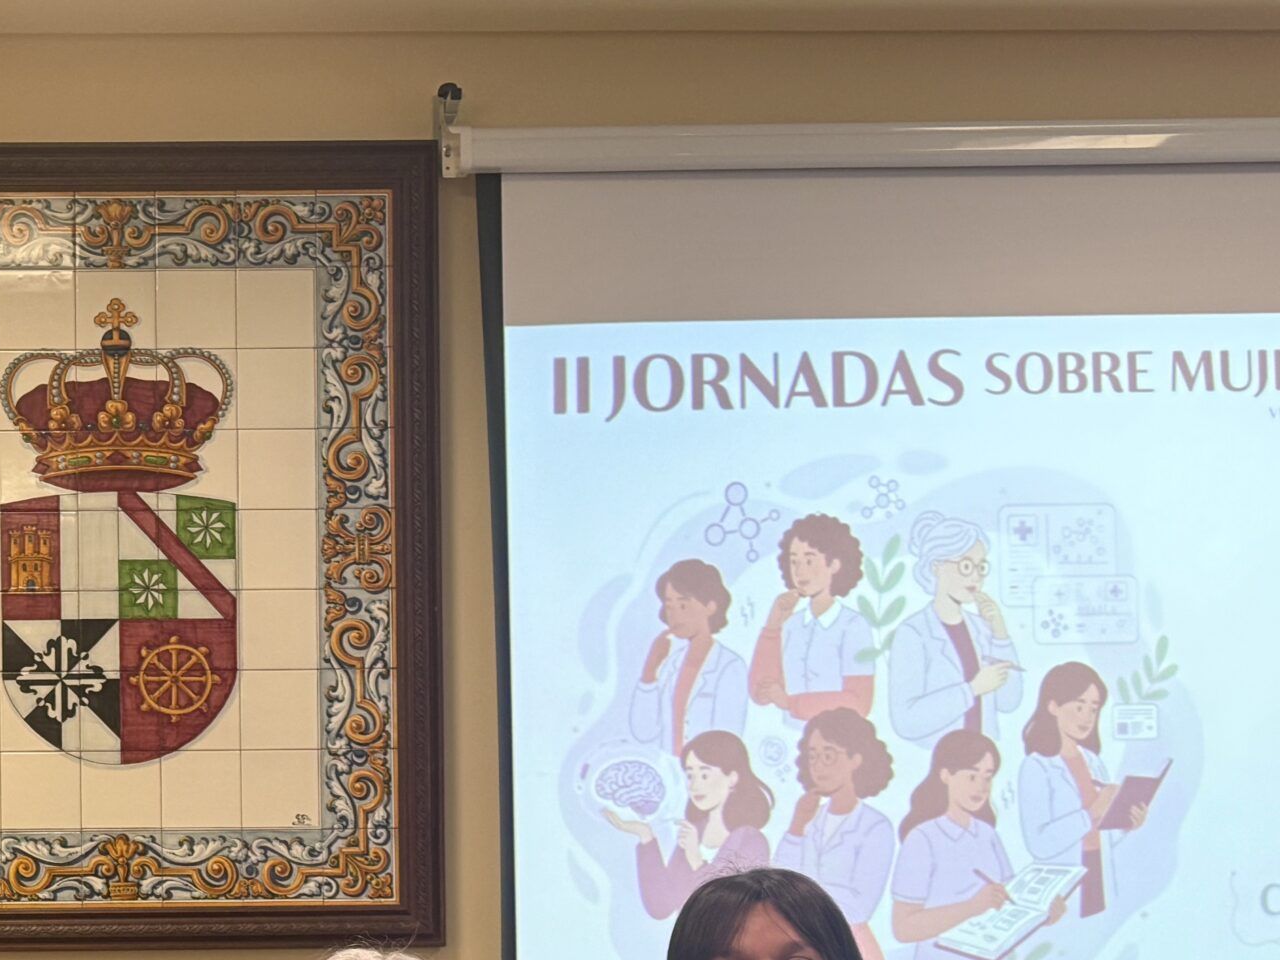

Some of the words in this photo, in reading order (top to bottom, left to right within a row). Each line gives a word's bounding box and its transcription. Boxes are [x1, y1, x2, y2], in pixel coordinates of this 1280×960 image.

[552, 356, 591, 415] II
[605, 349, 965, 422] JORNADAS
[984, 350, 1155, 396] SOBRE
[1171, 349, 1280, 398] MUJ
